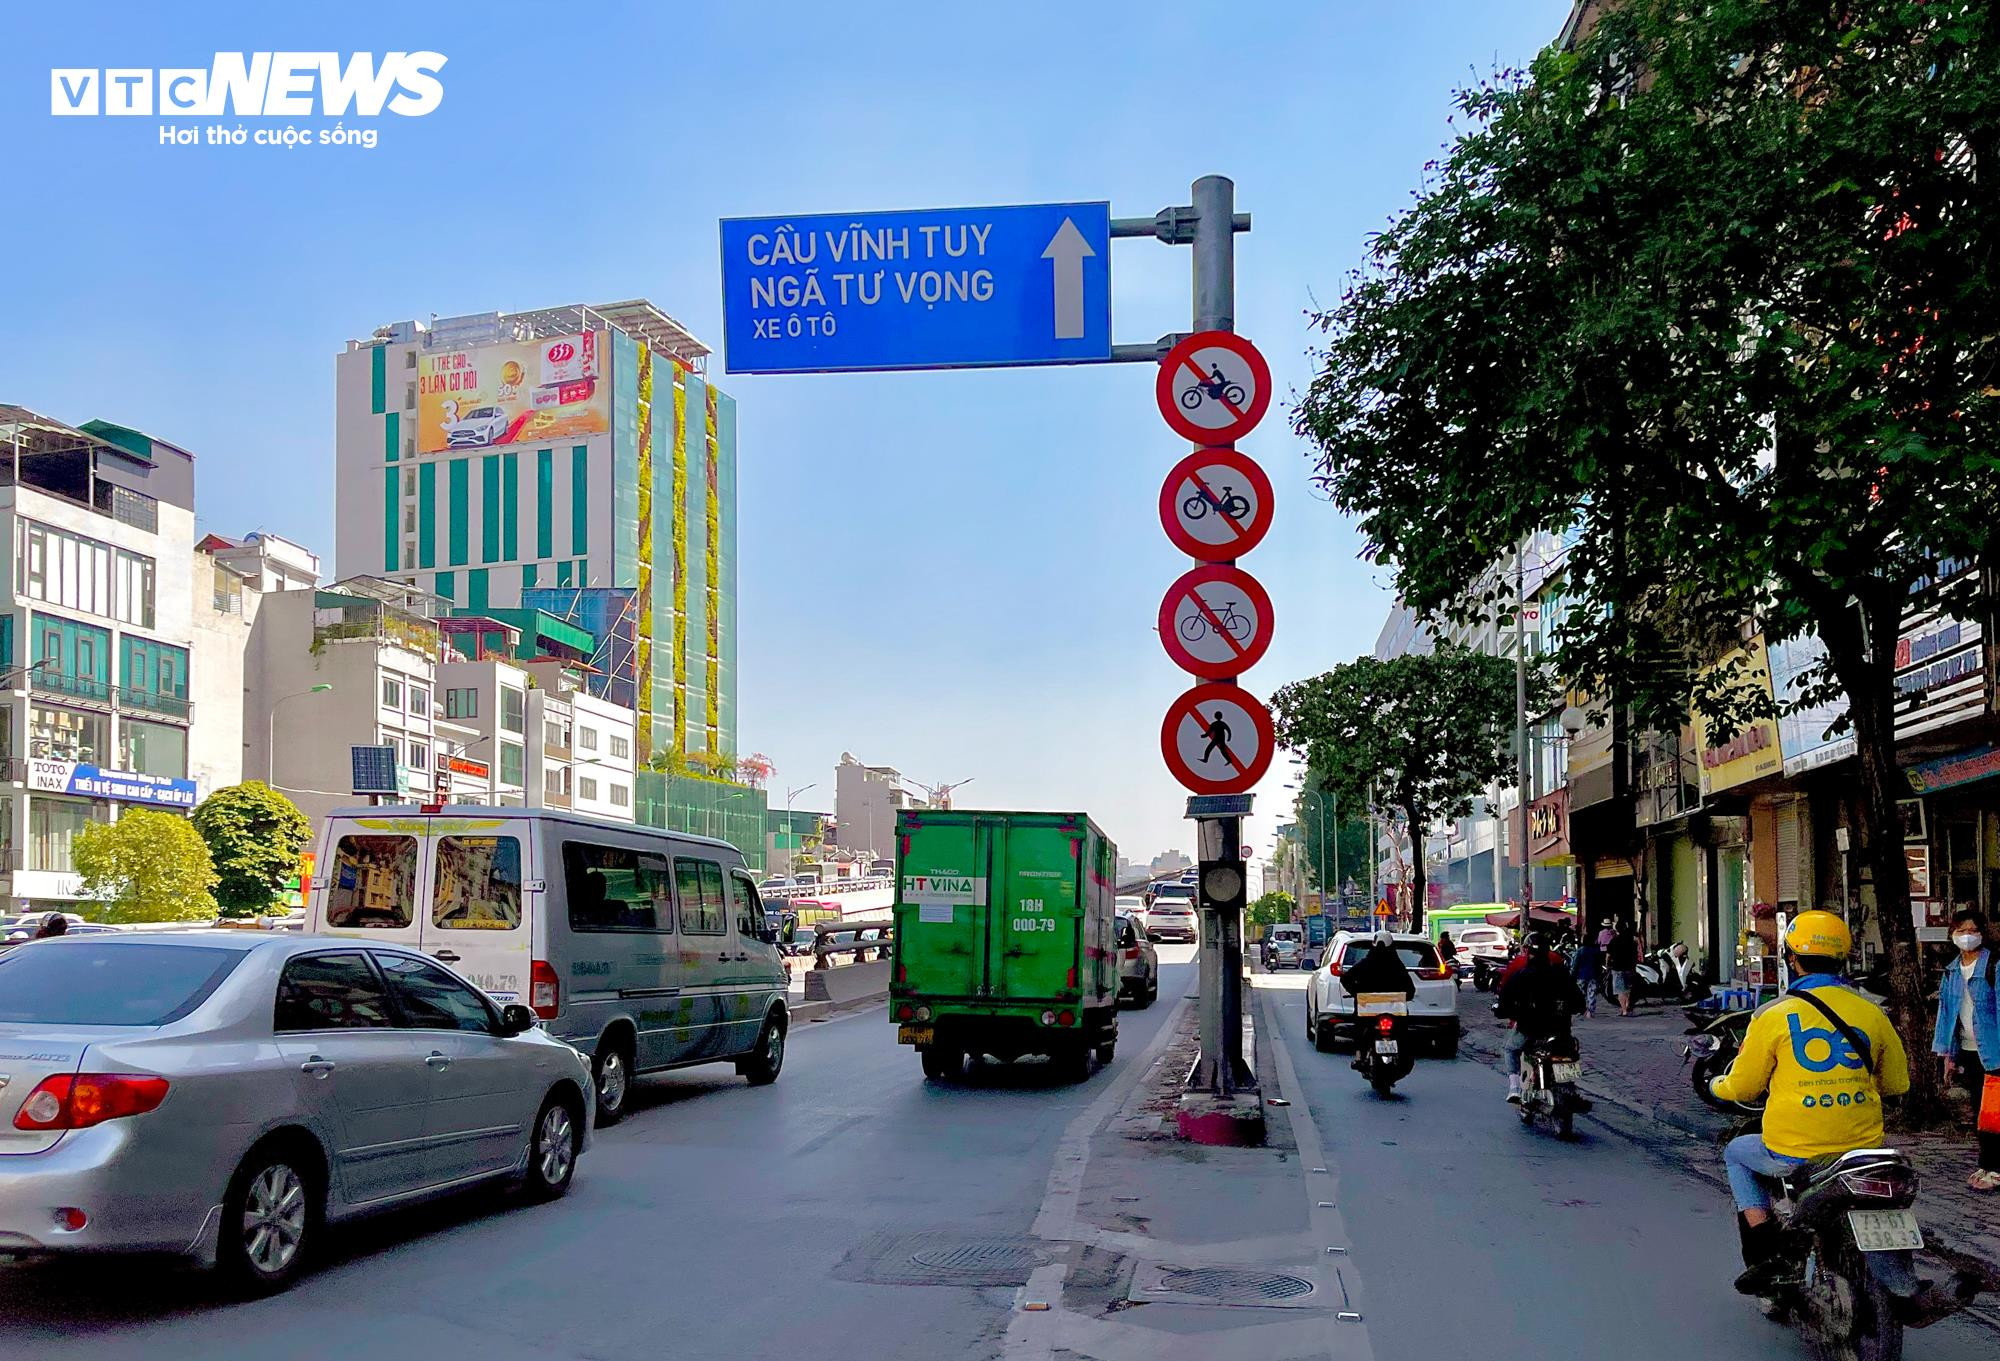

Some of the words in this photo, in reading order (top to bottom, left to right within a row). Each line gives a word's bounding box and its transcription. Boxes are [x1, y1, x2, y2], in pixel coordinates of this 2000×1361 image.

[748, 222, 817, 267] CẦU
[826, 223, 910, 263] VĨNH
[919, 223, 993, 258] TUY
[751, 268, 826, 309] NGÃ
[833, 270, 886, 307] TƯ
[895, 269, 994, 311] VỌNG
[752, 318, 781, 340] XE
[787, 312, 802, 338] Ô
[807, 311, 837, 338] TÔ
[420, 376, 426, 394] 3
[37, 776, 62, 790] INAX
[1019, 899, 1044, 912] 18H
[1787, 1012, 1871, 1072] be
